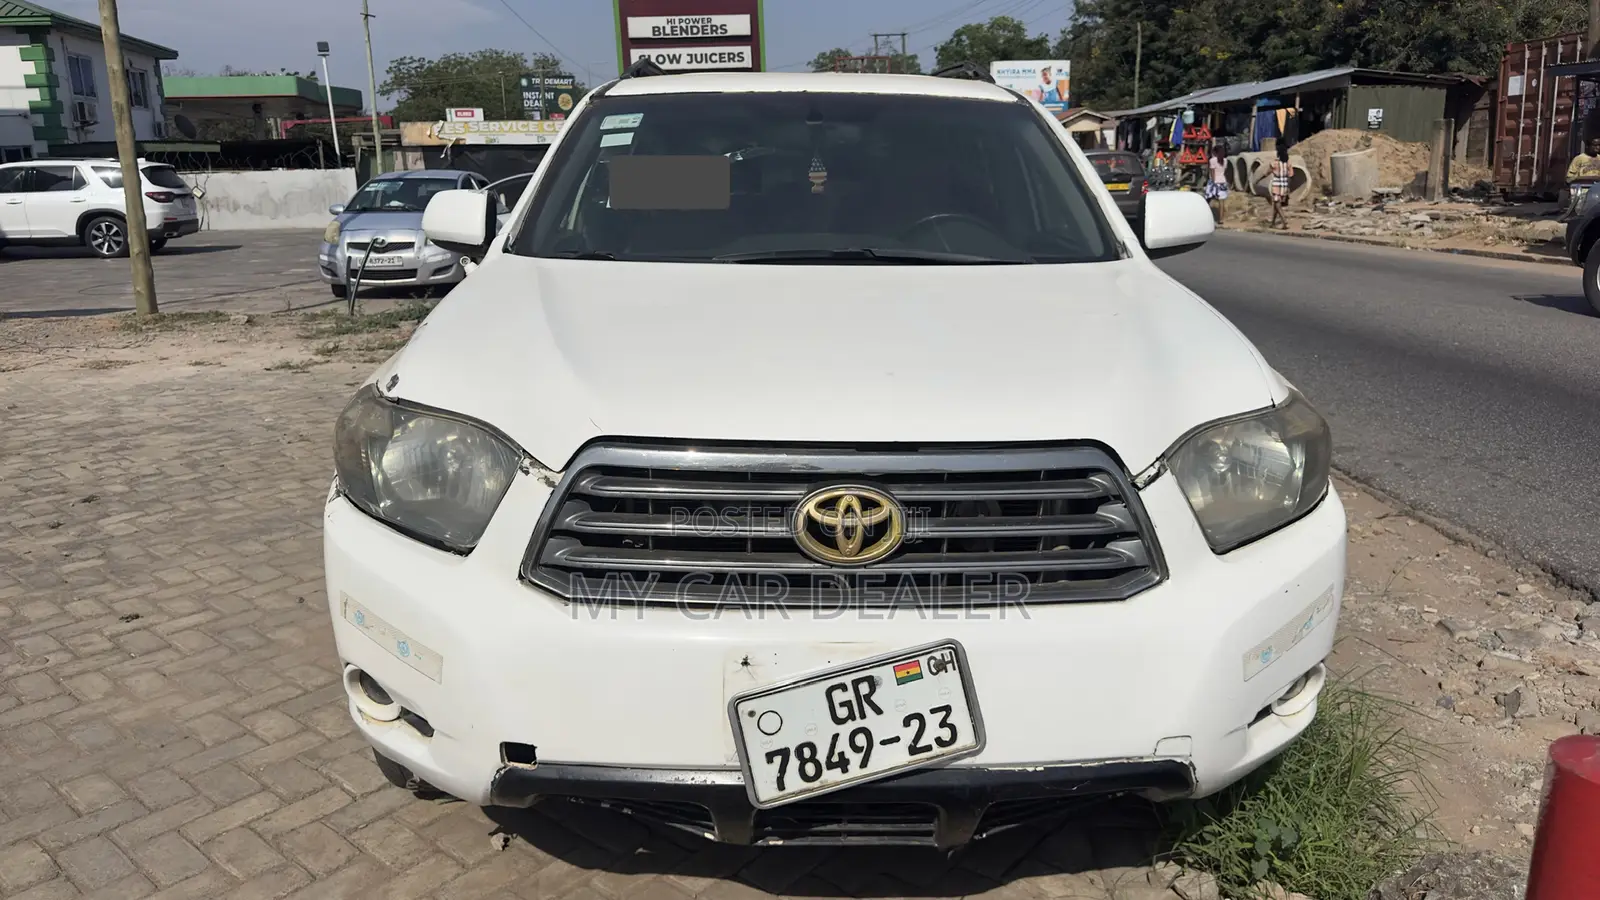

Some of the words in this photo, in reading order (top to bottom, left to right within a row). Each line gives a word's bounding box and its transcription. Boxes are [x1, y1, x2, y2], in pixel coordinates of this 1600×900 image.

[678, 17, 713, 25] POWER
[651, 24, 728, 37] BLENDERS
[686, 52, 745, 65] JUICERS
[469, 122, 537, 133] SERVICE
[825, 675, 884, 726] GR
[765, 704, 958, 792] 7849-23
